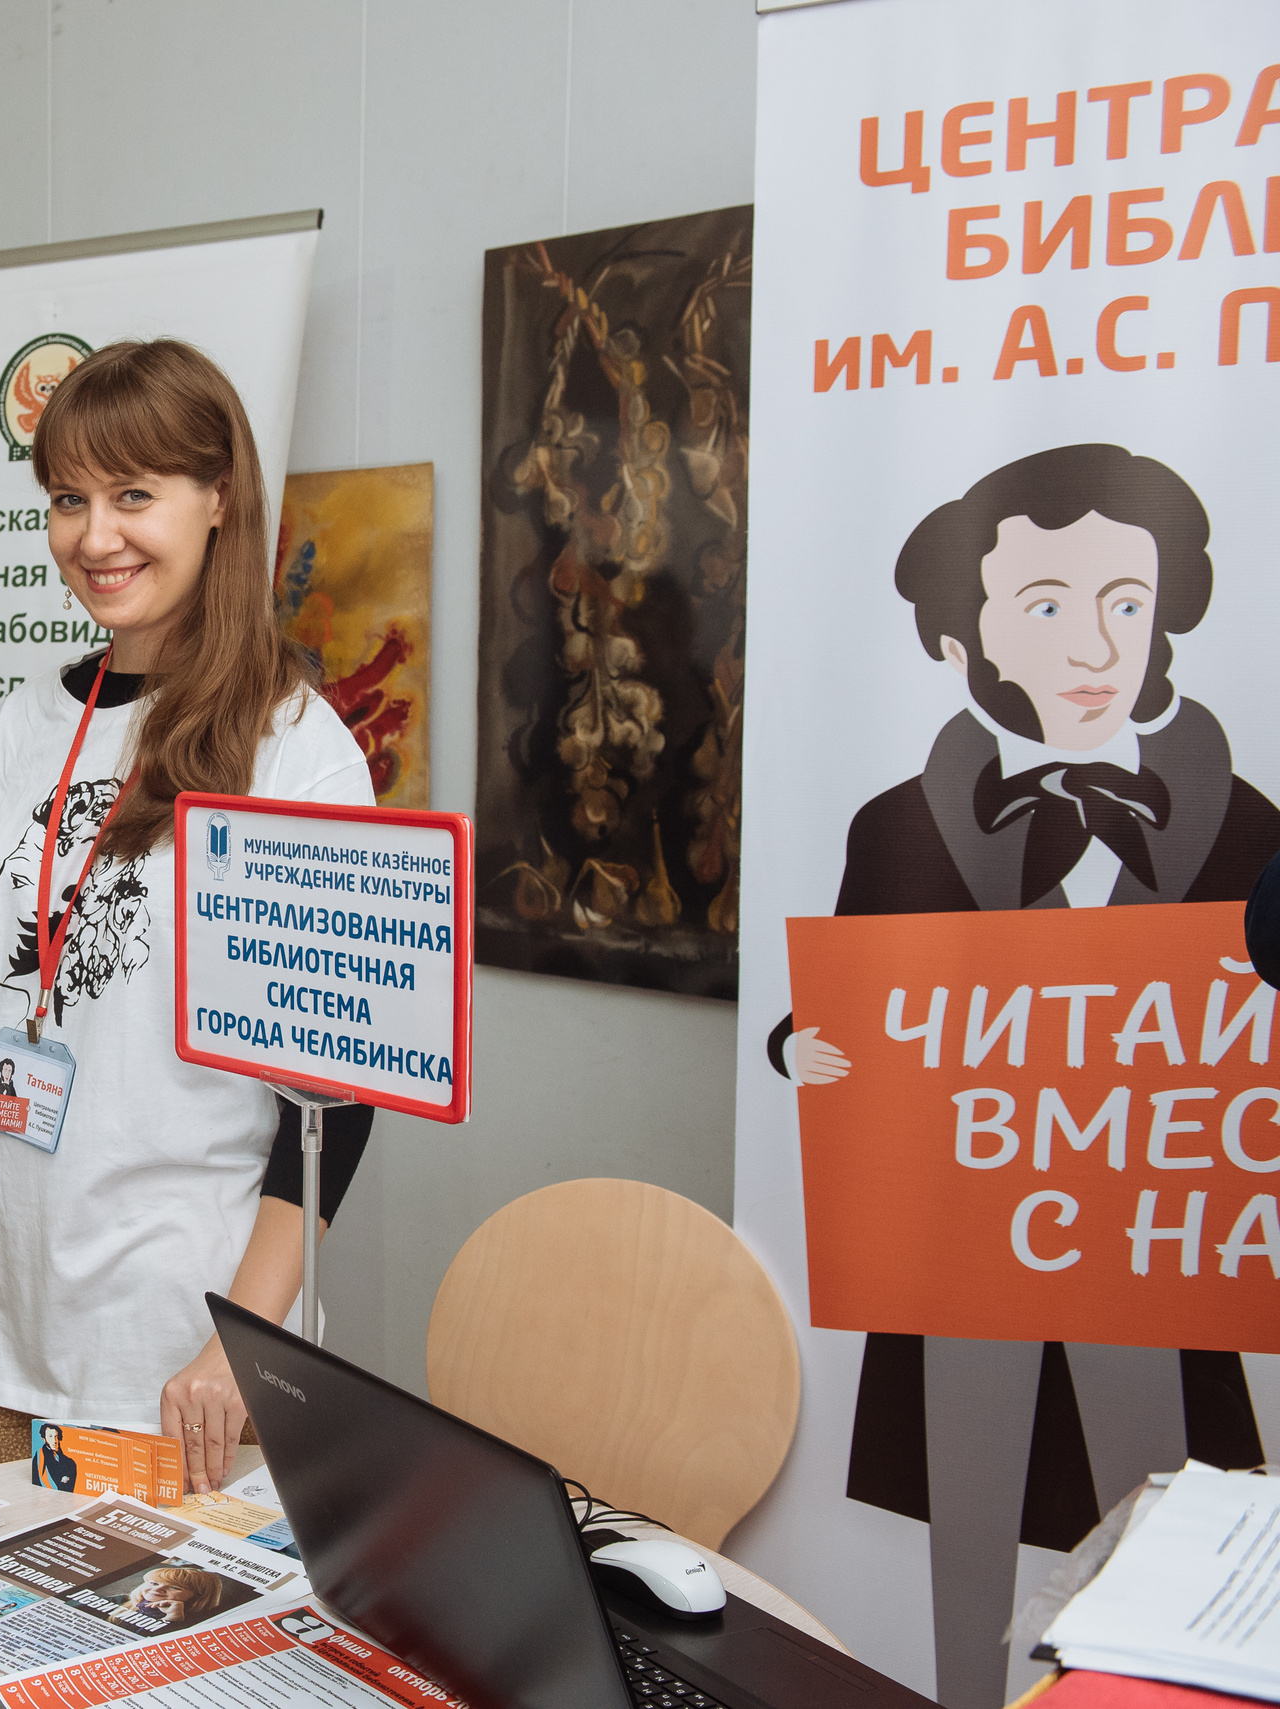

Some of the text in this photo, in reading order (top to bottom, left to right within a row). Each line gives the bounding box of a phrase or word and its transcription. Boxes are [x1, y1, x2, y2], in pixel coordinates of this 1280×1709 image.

[946, 175, 1280, 281] БИБЛ
[813, 329, 960, 393] ИМ.
[244, 838, 451, 876] МУНИЦИПАЛЬНОЕ КАЗЁННОЕ
[245, 861, 451, 905] УЧРЕЖДЕНИЕ КУЛЬТУРЫ
[197, 892, 452, 954] ЦЕНТРАЛИЗОВАННАЯ
[227, 935, 416, 991] БИБЛИОТЕЧНАЯ
[267, 982, 371, 1025] СИСТЕМА
[197, 1007, 454, 1085] ГОРОДА ЧЕЛЯБИНСКА
[27, 1073, 63, 1097] Татьяна
[1, 1118, 23, 1129] НАМИ!
[1011, 1190, 1082, 1272] С
[255, 1361, 306, 1403] Lenovo
[84, 1472, 119, 1483] ЧИТАТЕЛЬСКИЙ
[86, 1479, 119, 1493] БИЛЕТ
[95, 1509, 127, 1525] 5
[120, 1514, 177, 1538] октября
[187, 1540, 282, 1579] ЦЕНТРАЛЬНАЯ БИБЛИОТЕКА
[238, 1569, 270, 1585] Пушкина
[685, 1567, 703, 1576] Genius
[66, 1588, 171, 1633] Левитиной
[171, 1652, 184, 1662] 16
[52, 1673, 64, 1681] 8
[387, 1665, 448, 1702] октябрь
